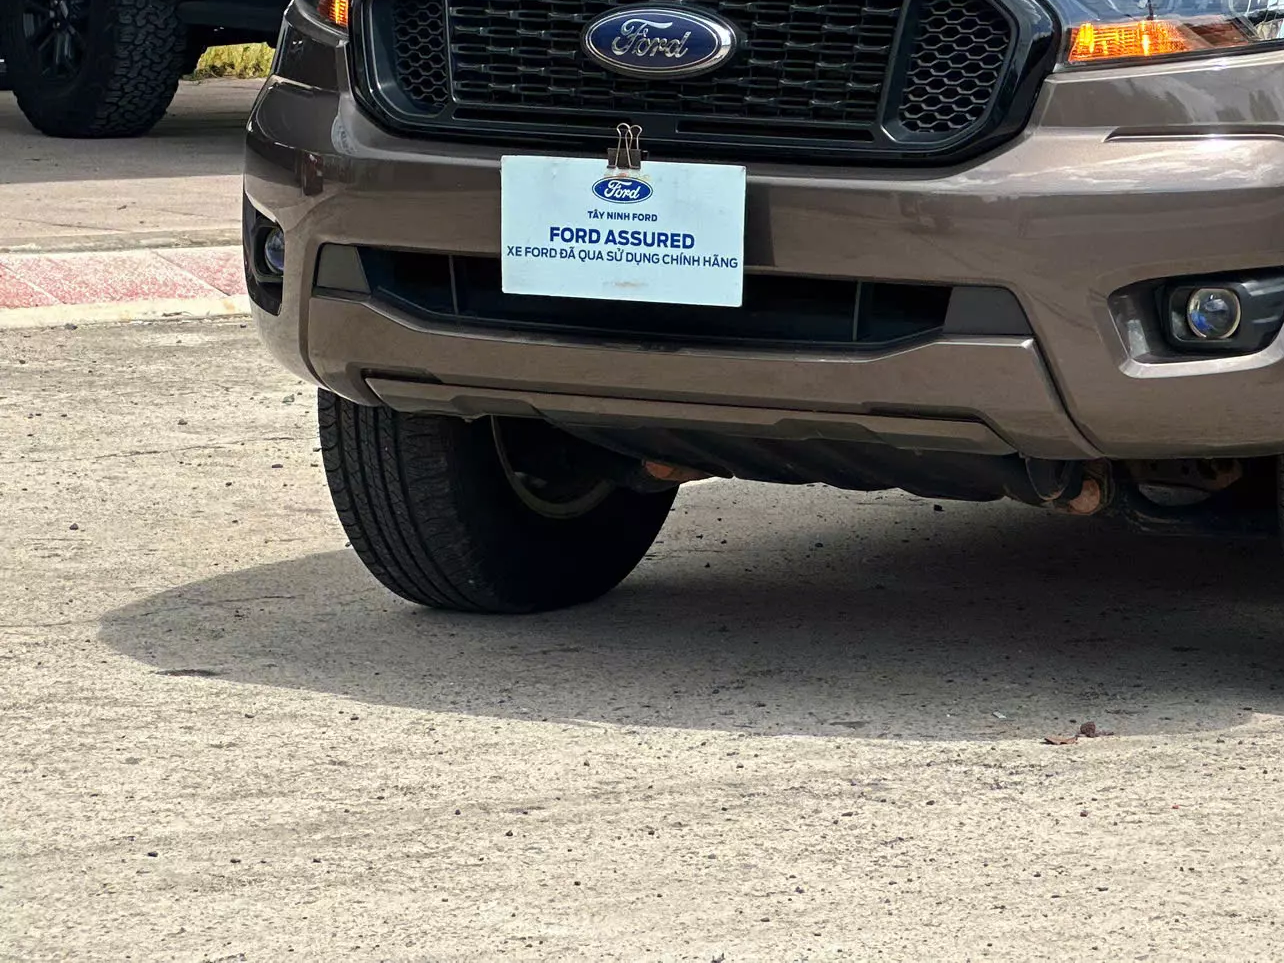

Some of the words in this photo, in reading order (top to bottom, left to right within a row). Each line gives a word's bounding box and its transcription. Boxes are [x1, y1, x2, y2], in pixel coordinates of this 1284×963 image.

[611, 17, 693, 59] Ford
[603, 179, 641, 200] Ford
[587, 208, 605, 220] TÂY
[606, 211, 631, 221] NINH
[632, 211, 658, 222] FORD
[549, 226, 601, 245] FORD
[604, 229, 696, 250] ASSURED
[506, 245, 523, 258] XE
[524, 246, 558, 259] FORD
[559, 245, 576, 261] ĐÃ
[578, 249, 604, 263] QUA
[606, 246, 624, 262] SỬ
[625, 252, 660, 266] DỤNG
[662, 252, 701, 266] CHÍNH
[703, 254, 739, 269] HÃNG
